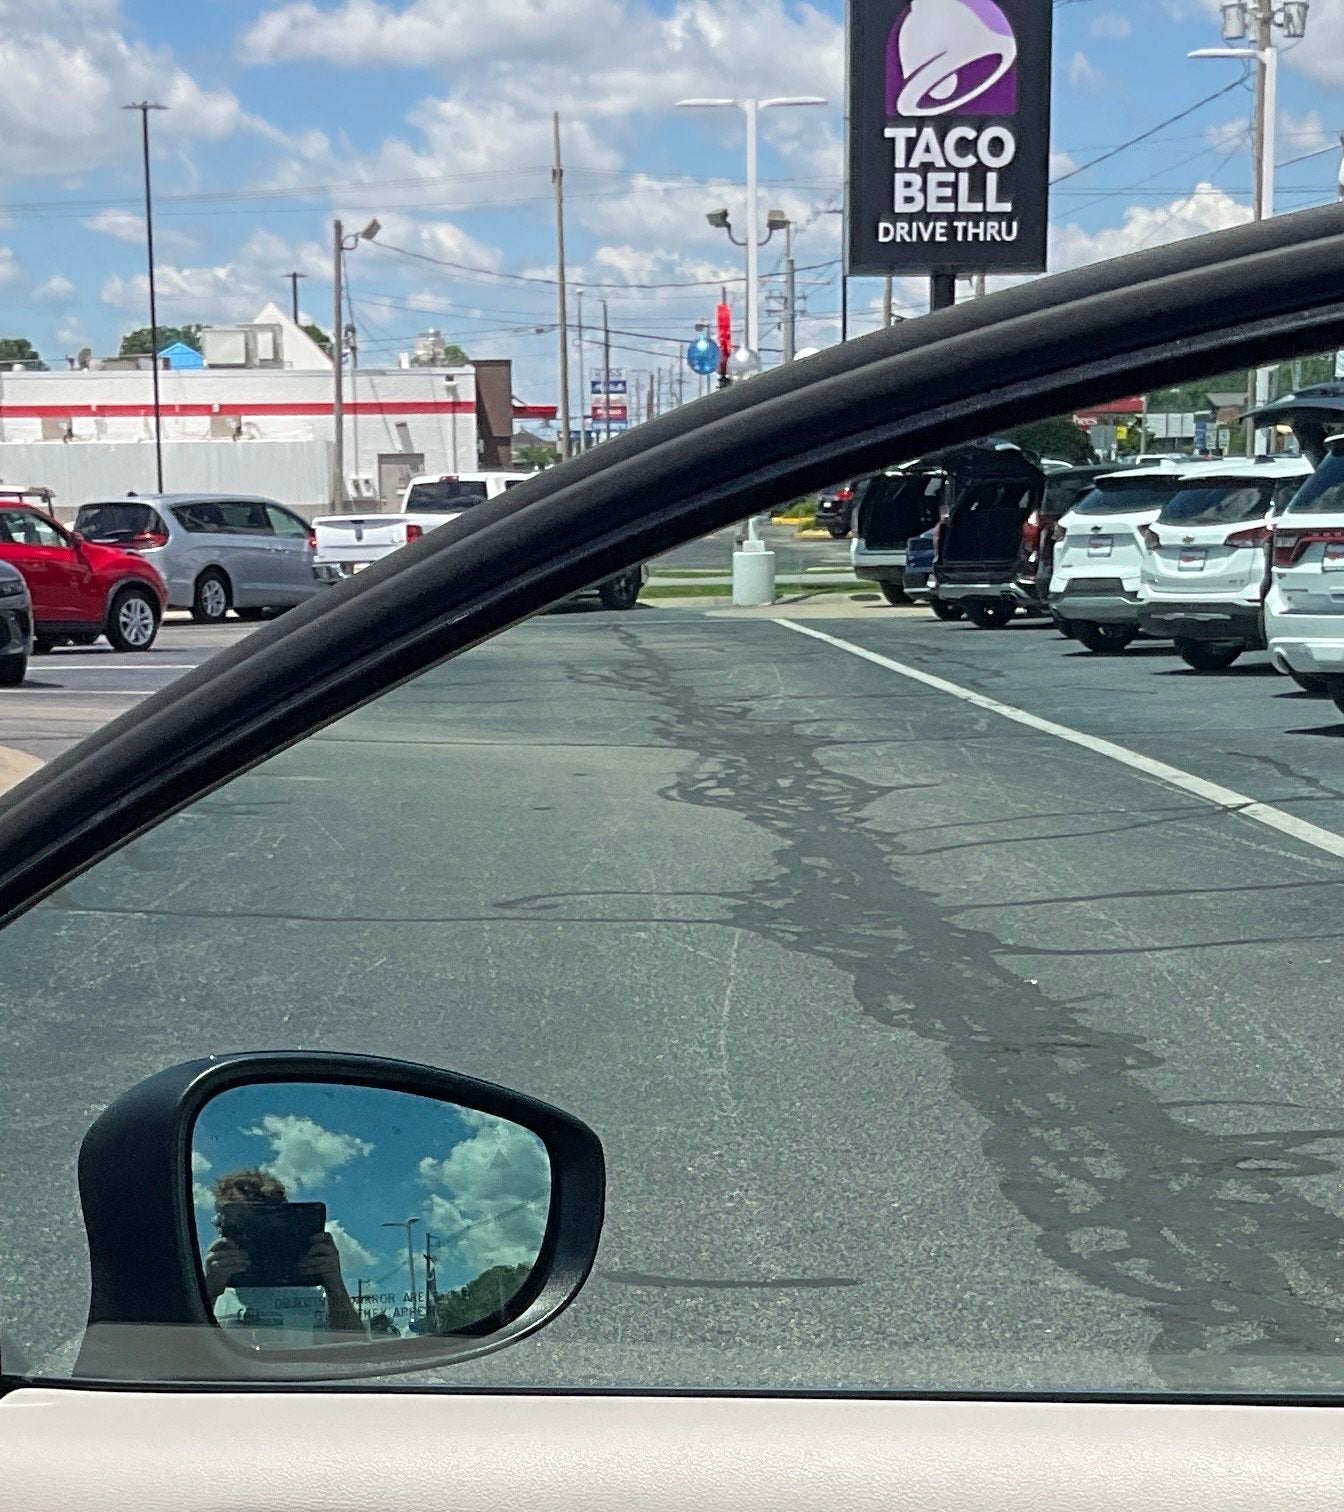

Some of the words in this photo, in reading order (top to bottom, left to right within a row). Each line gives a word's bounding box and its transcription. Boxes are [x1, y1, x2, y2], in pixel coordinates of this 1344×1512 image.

[883, 126, 1016, 168] TACO
[893, 171, 1013, 214] BELL
[877, 221, 948, 243] DRIVE
[953, 220, 1018, 242] THRU
